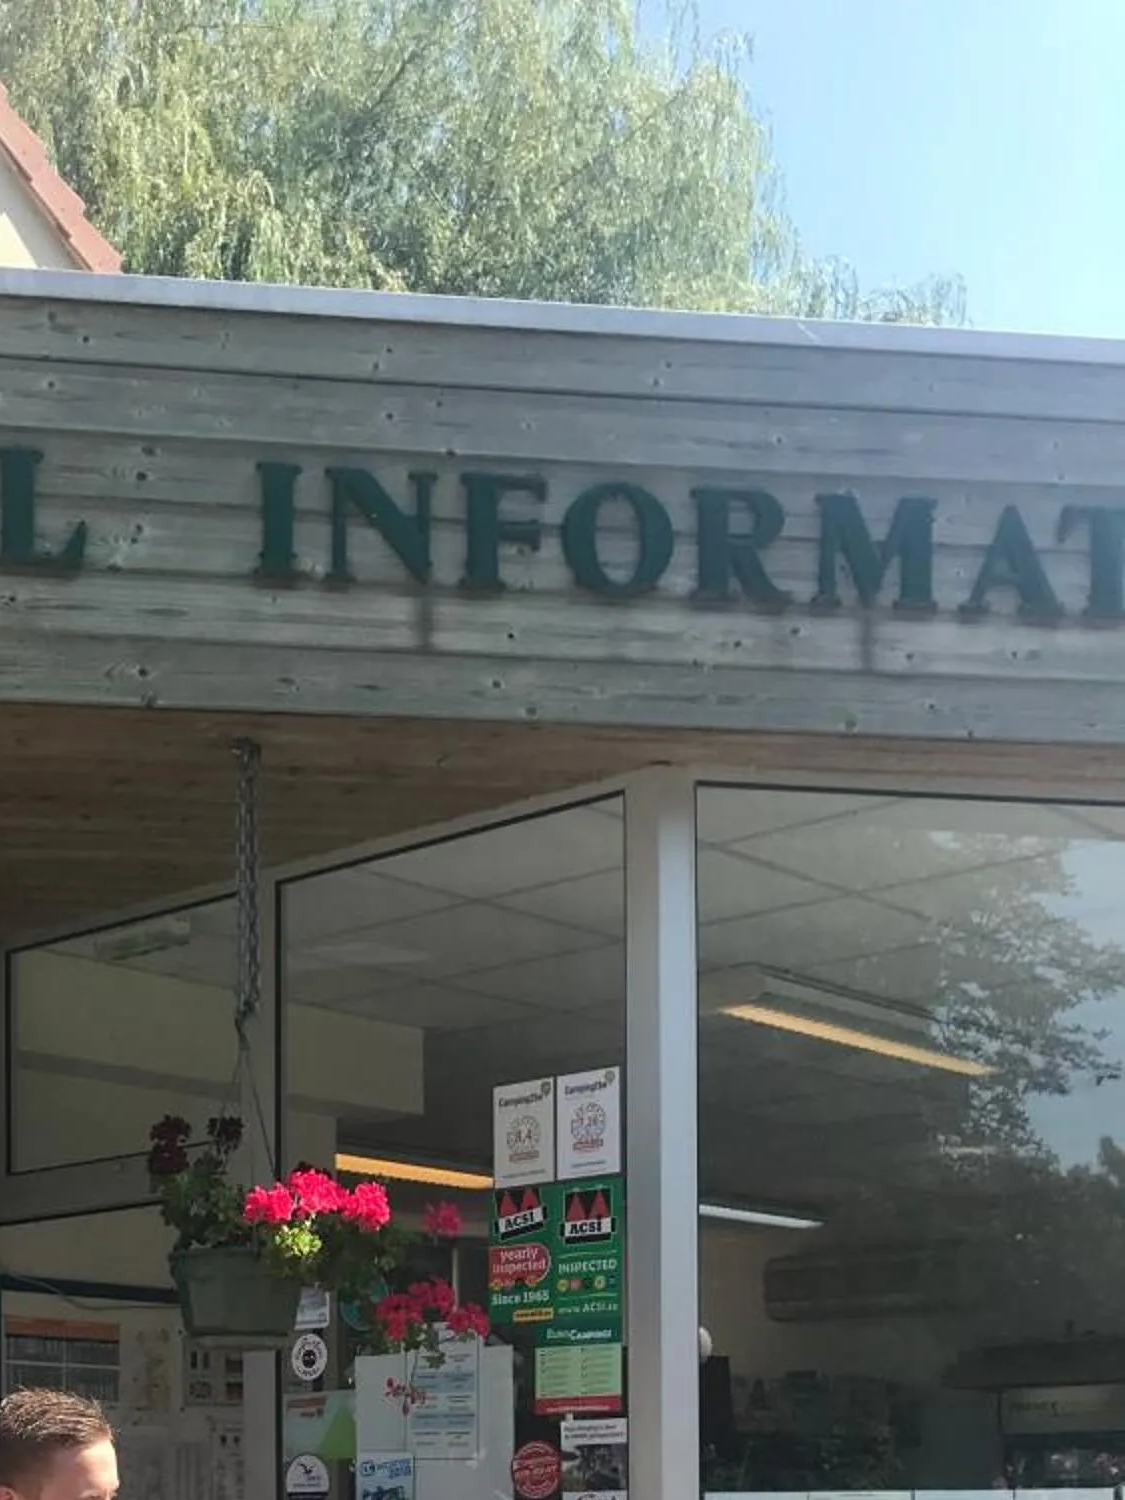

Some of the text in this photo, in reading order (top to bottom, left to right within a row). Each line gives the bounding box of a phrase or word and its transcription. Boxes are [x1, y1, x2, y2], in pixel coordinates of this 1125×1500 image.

[254, 460, 1125, 622] INFORMAT
[504, 1213, 535, 1230] ACSI
[569, 1221, 602, 1235] ACSI
[500, 1247, 538, 1263] yearly
[492, 1259, 546, 1275] inspected
[558, 1259, 617, 1274] INSPECTED
[491, 1290, 550, 1306] Since 1965
